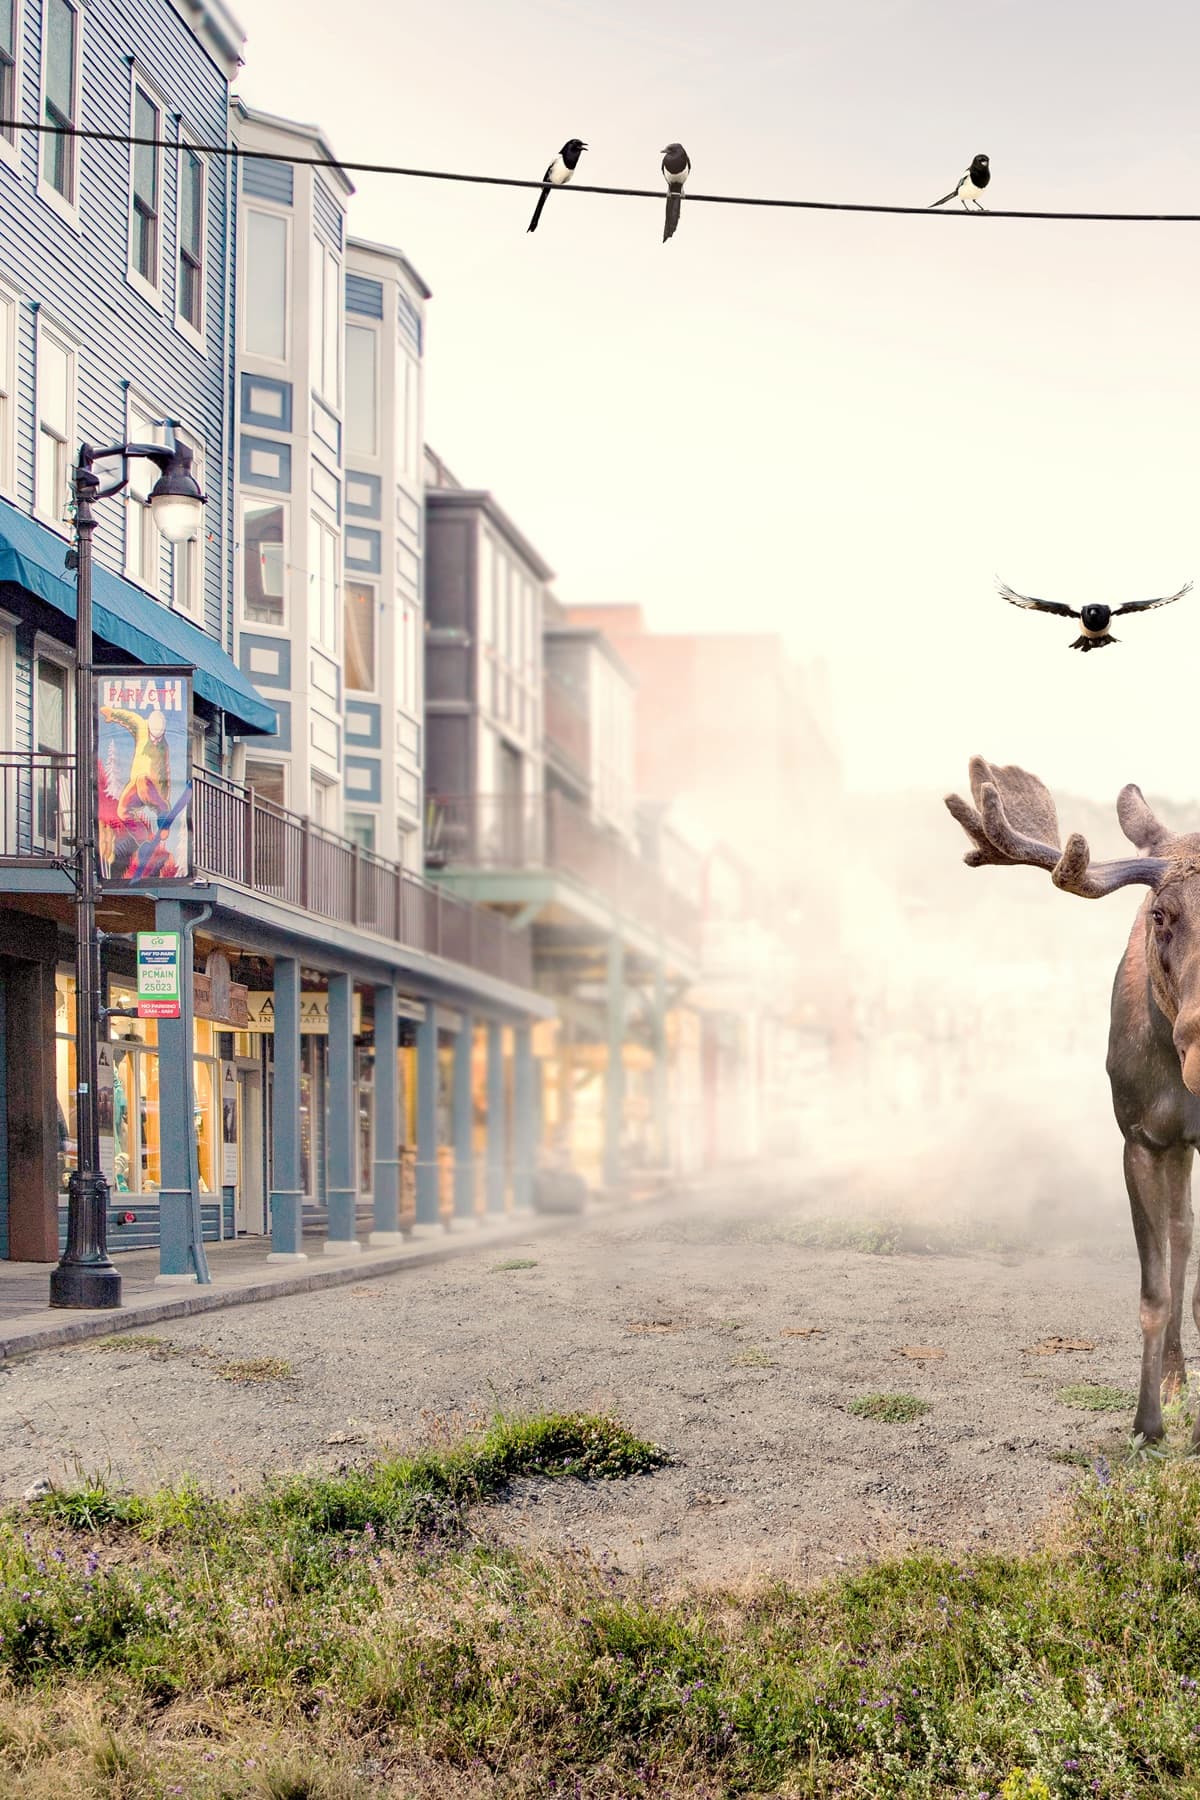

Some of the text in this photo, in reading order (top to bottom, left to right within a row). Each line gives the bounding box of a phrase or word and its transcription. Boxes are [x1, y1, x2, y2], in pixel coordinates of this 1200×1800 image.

[104, 680, 182, 711] UTAH
[109, 688, 176, 703] PARK CITY
[142, 970, 174, 978] PCMAIN
[144, 983, 172, 991] 25023
